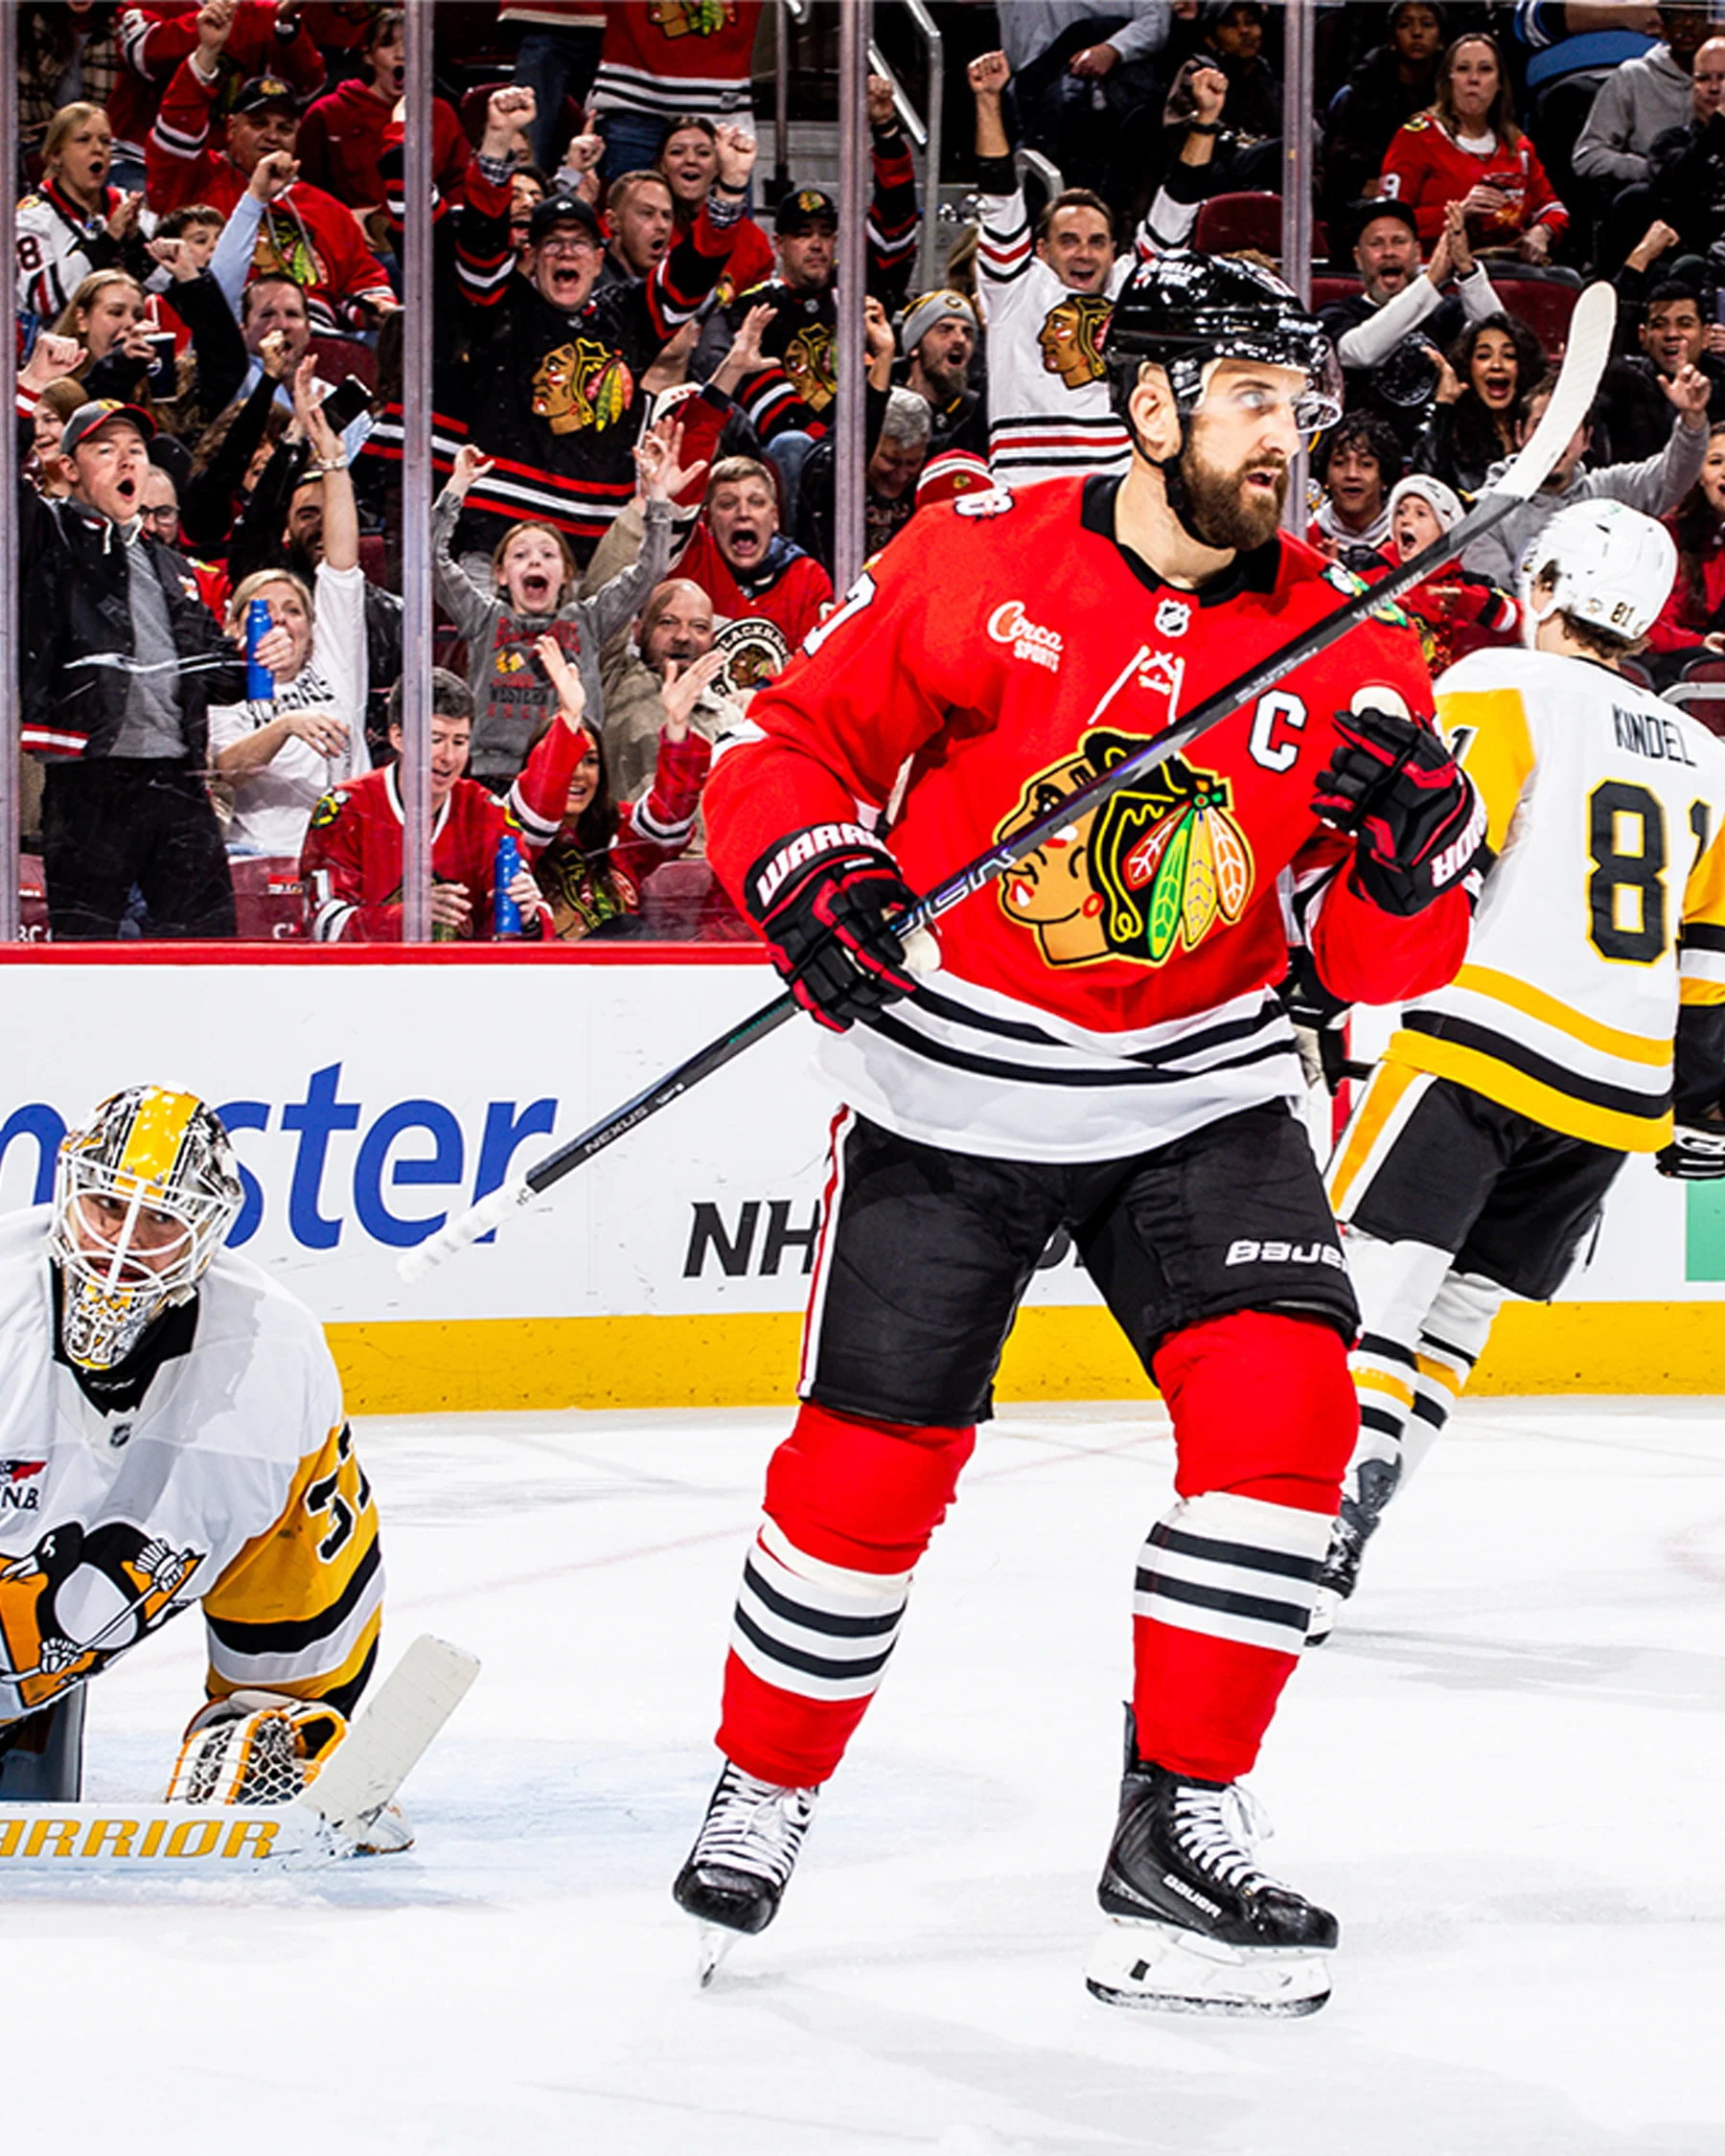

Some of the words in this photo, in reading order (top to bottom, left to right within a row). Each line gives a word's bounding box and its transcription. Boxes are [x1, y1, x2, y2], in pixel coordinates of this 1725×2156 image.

[16, 235, 44, 272] 8
[1610, 601, 1635, 628] 81
[1248, 687, 1308, 774] C
[1612, 702, 1697, 768] KINDEL
[584, 1106, 649, 1154] NEXUS
